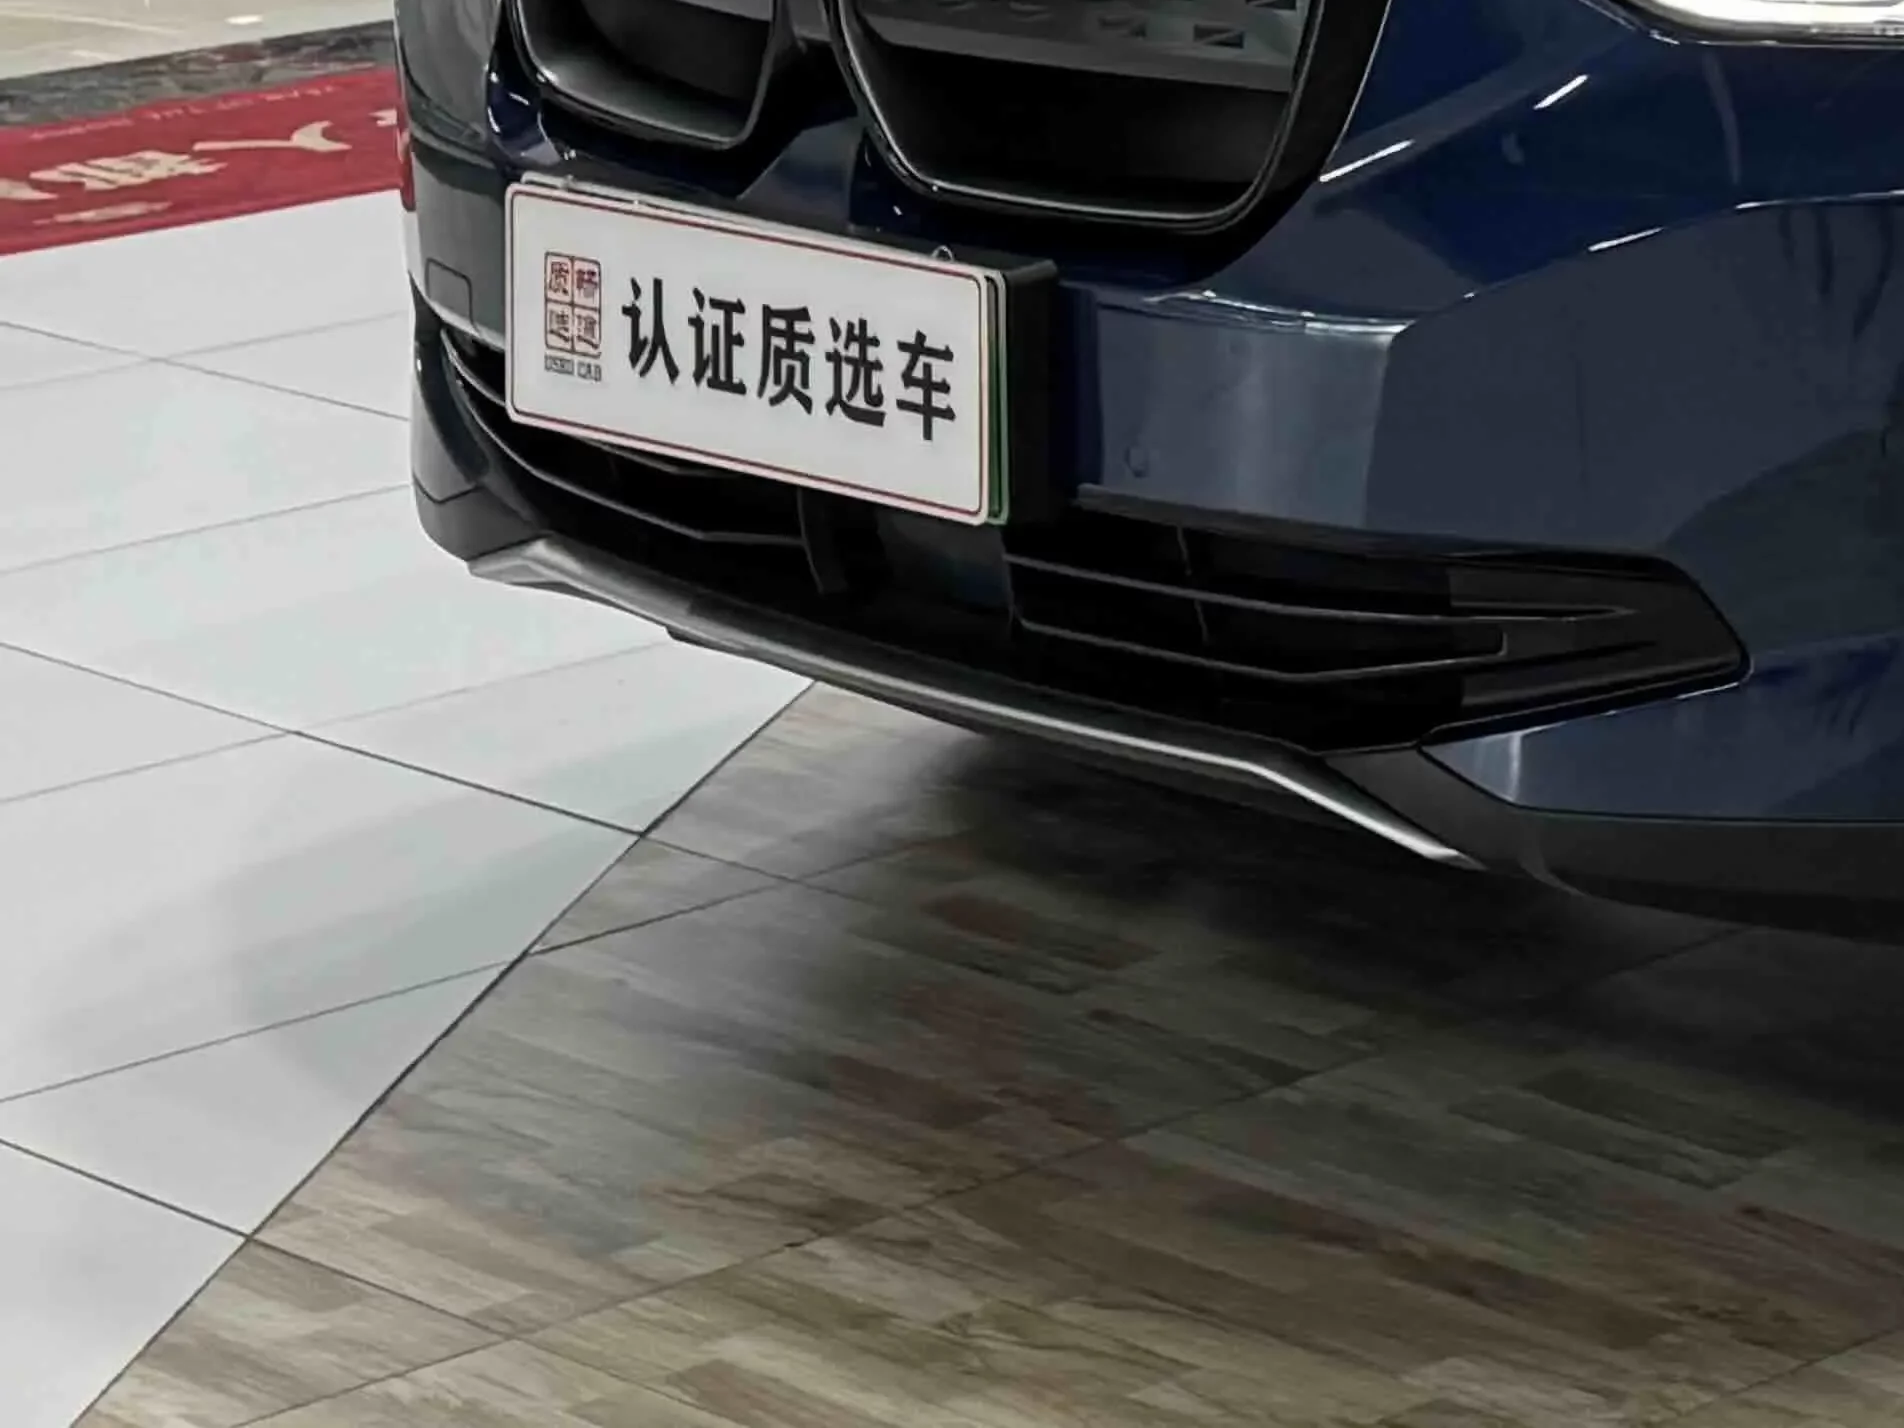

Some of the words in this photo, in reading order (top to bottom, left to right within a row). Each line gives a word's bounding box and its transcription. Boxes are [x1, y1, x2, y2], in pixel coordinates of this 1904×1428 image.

[621, 277, 957, 441] 认证质选车
